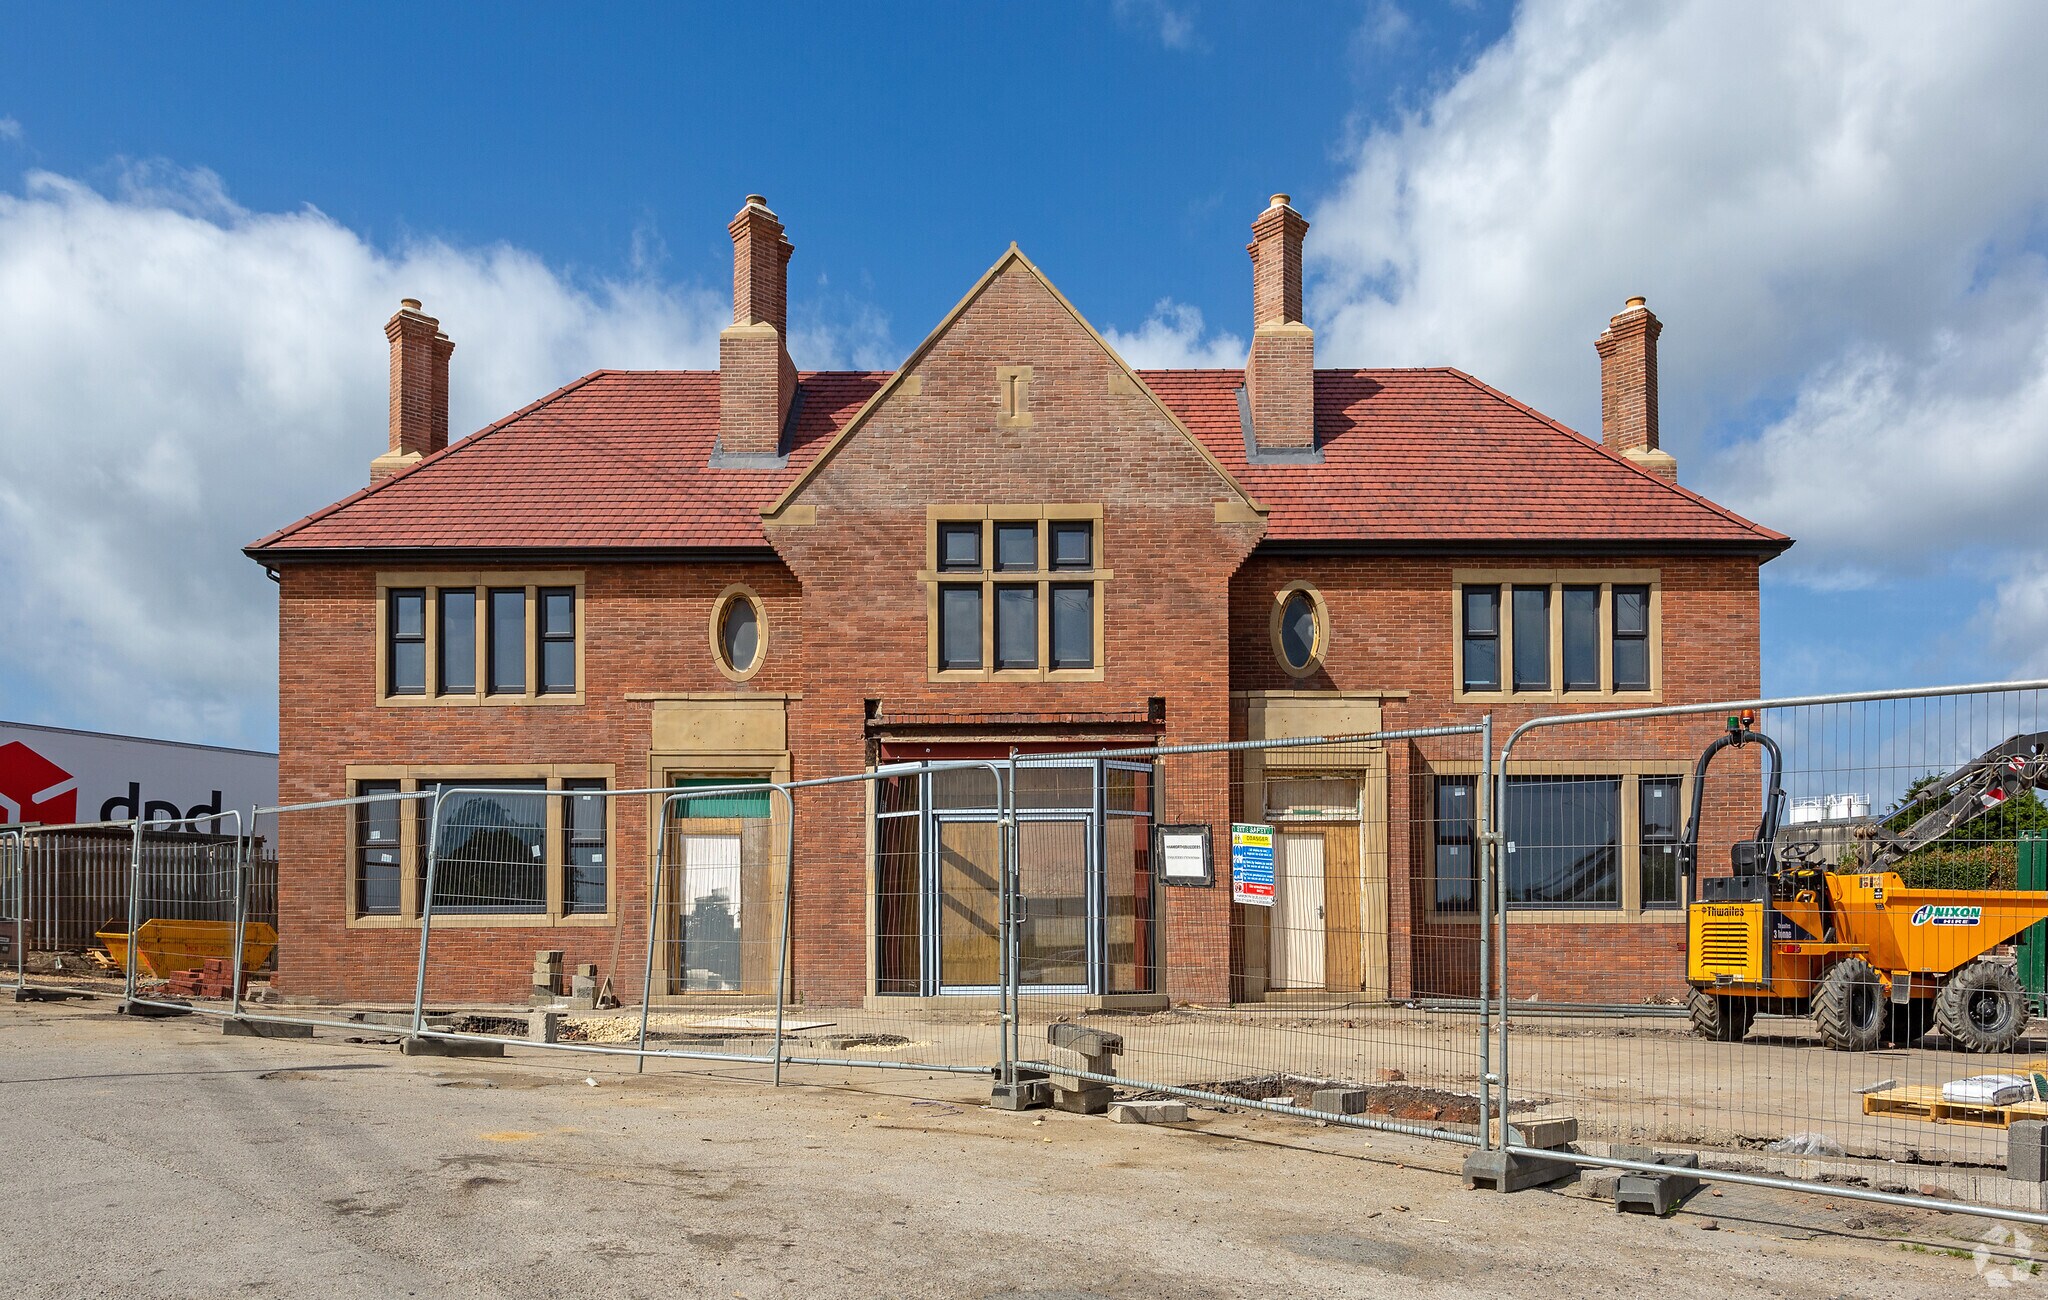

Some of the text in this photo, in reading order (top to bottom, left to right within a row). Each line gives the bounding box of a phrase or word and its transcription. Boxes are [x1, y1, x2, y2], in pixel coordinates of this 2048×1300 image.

[100, 782, 222, 834] dpd
[1707, 906, 1744, 916] Thwaites
[1934, 907, 1980, 917] NIXON
[1773, 929, 1777, 939] 3
